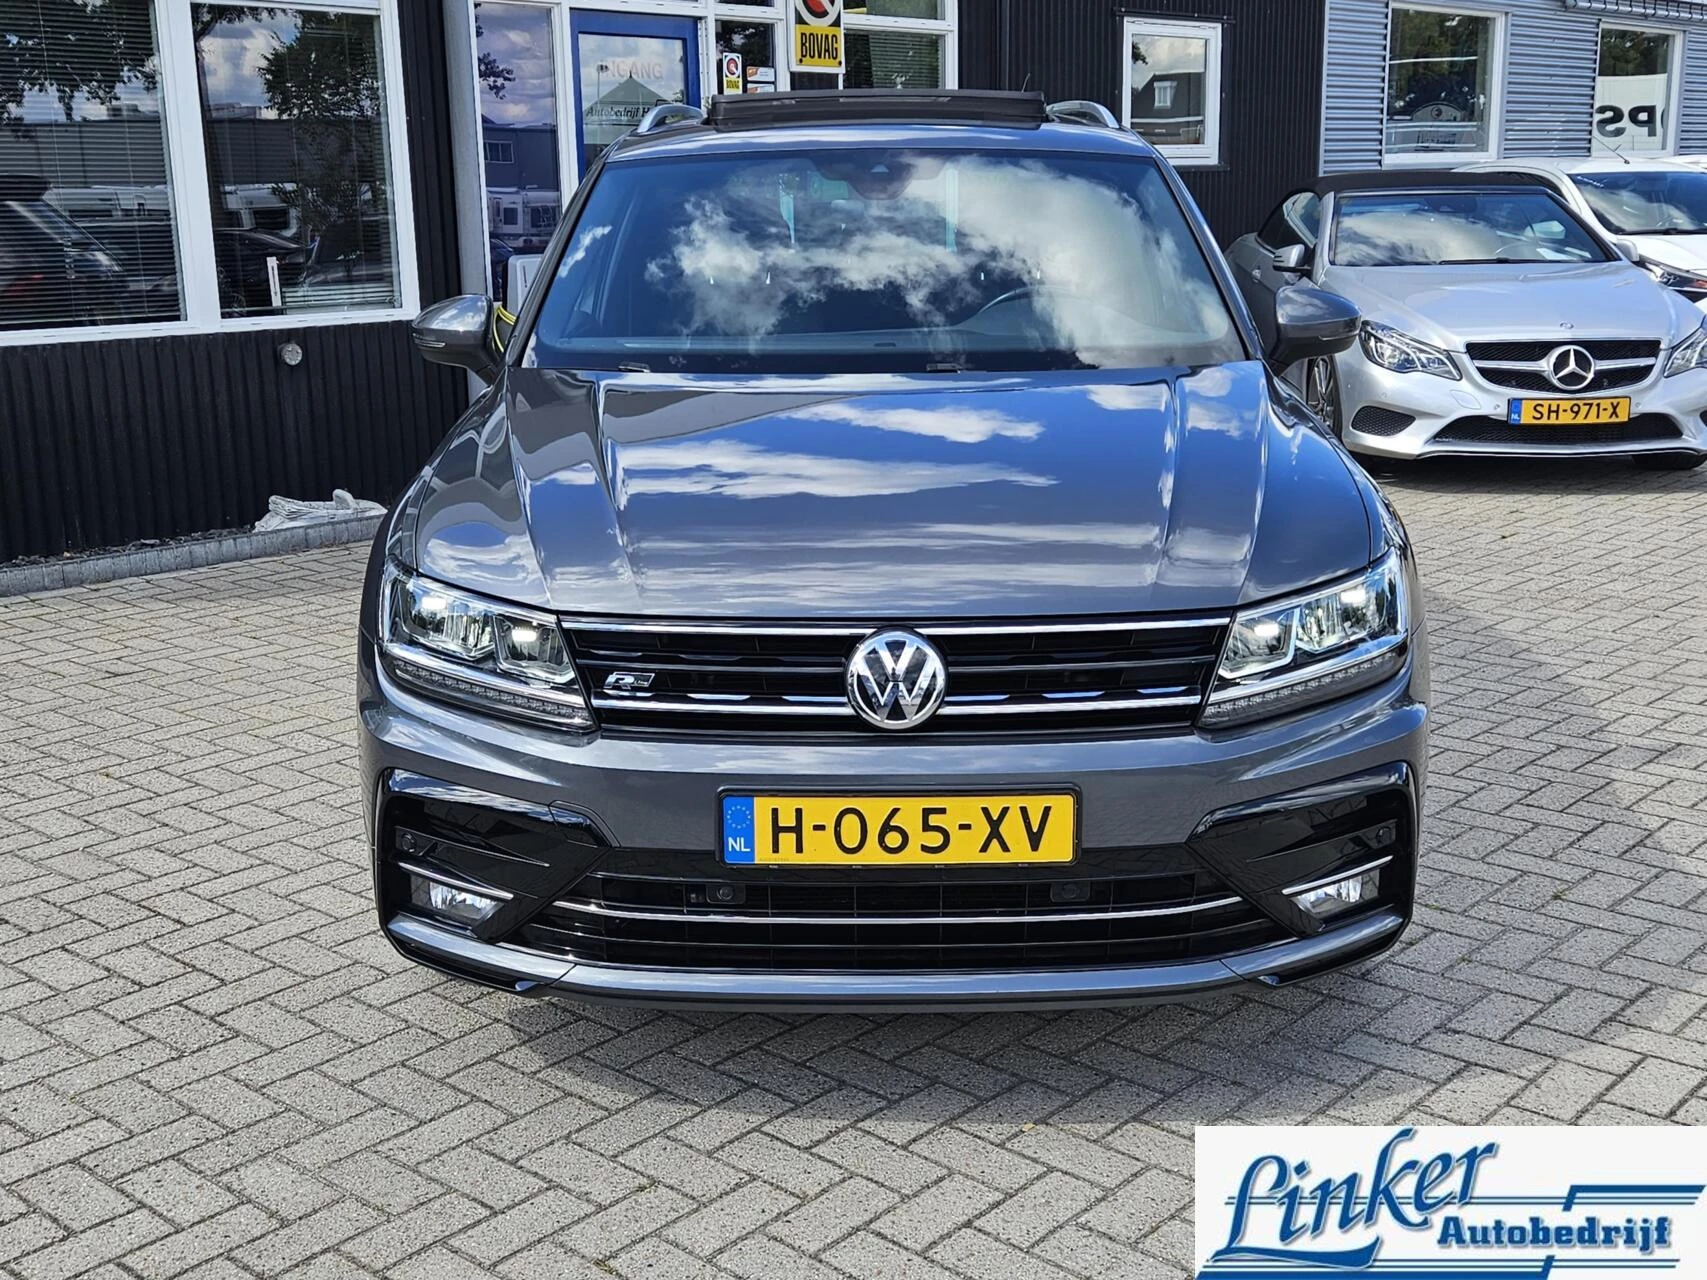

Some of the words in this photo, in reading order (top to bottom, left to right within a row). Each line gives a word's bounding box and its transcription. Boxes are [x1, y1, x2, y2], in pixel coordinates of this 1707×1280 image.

[800, 32, 838, 60] BOVAG
[600, 60, 664, 80] NGANG
[725, 79, 740, 89] BOVAG
[585, 106, 641, 120] Autobedrijf
[1532, 401, 1620, 421] SH-971-X
[728, 837, 750, 852] NL
[771, 805, 1053, 855] H-065-XV
